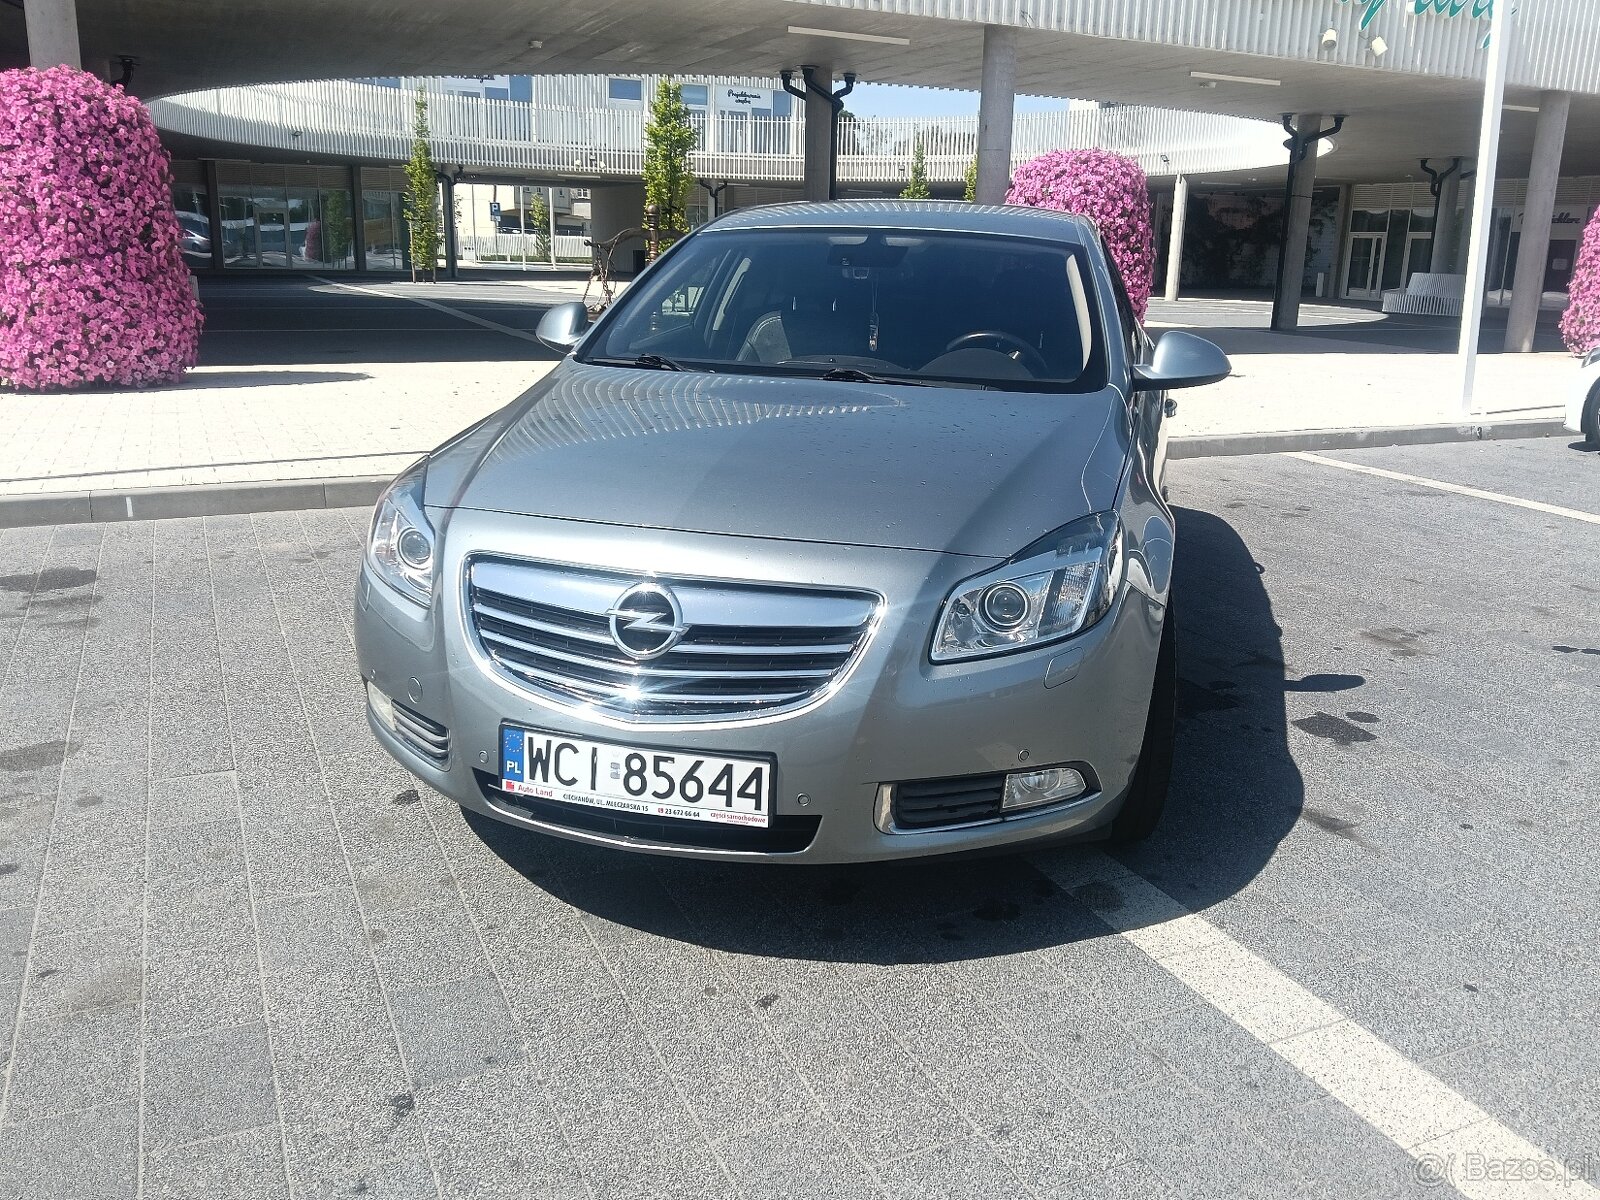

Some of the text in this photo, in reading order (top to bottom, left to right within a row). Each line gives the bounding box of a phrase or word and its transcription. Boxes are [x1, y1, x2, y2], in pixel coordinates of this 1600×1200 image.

[506, 760, 522, 774] PL
[527, 736, 763, 811] WCI 85644
[518, 784, 553, 797] Auto Land
[727, 814, 766, 824] samochodowe
